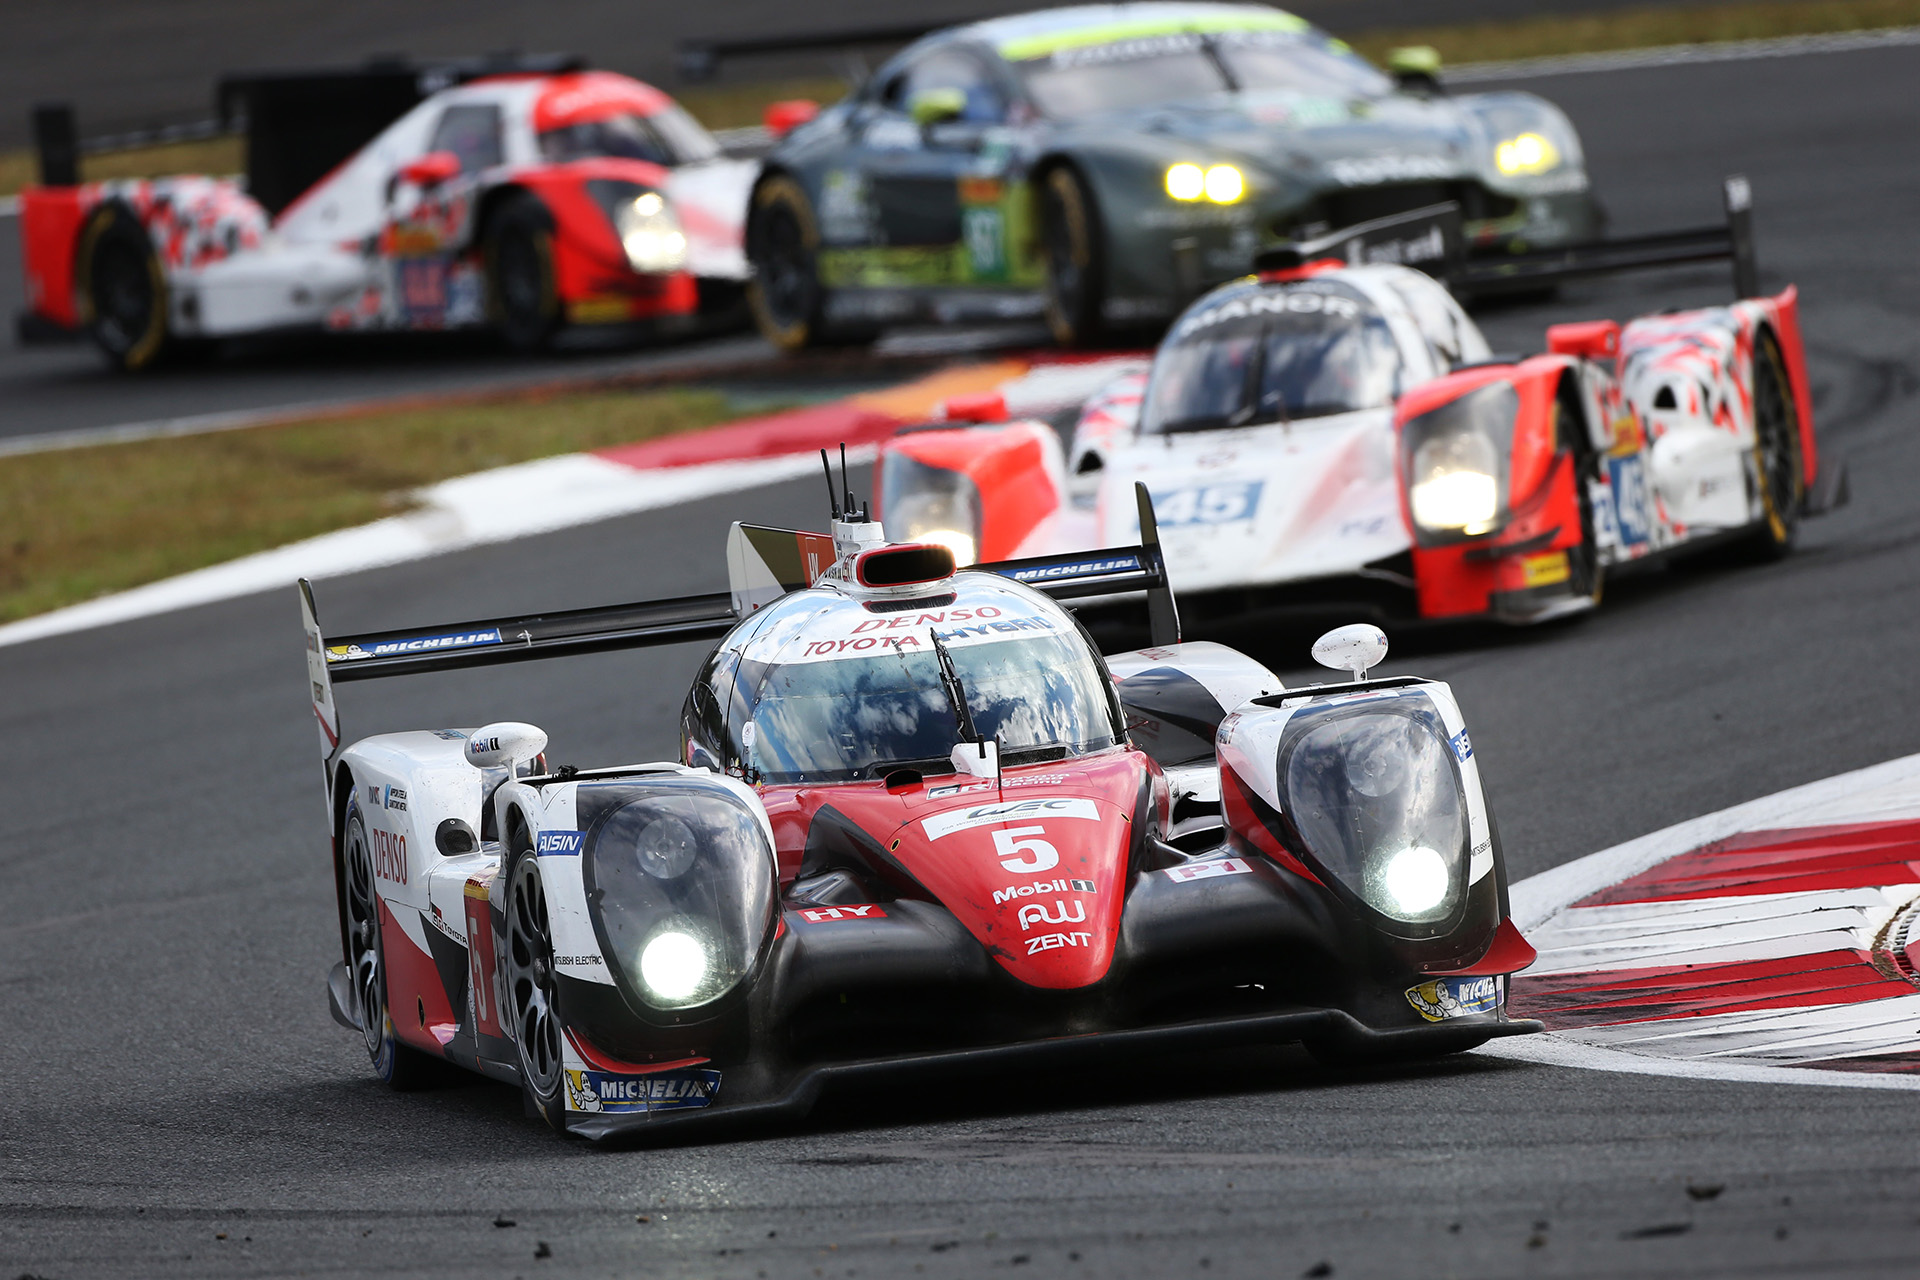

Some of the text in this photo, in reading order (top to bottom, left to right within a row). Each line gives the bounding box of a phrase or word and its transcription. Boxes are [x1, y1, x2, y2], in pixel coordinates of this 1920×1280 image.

[1014, 559, 1134, 580] MICHELIN
[850, 606, 1002, 634] DENSO
[375, 632, 496, 654] MICHELIN
[803, 616, 1056, 657] TOYOTA HYBRID
[471, 739, 489, 754] Mobil
[538, 835, 580, 852] AISIN
[991, 825, 1060, 873] 5
[373, 828, 408, 886] DENSO
[1178, 861, 1237, 878] P1
[993, 879, 1068, 905] Mobil
[804, 905, 873, 921] HY
[443, 921, 468, 945] TOYOTA
[1024, 932, 1092, 956] ZENT
[469, 916, 487, 1022] 5
[575, 955, 602, 966] ELECTRIC
[1459, 976, 1496, 1002] MICHE
[601, 1079, 715, 1098] MICHELIN
